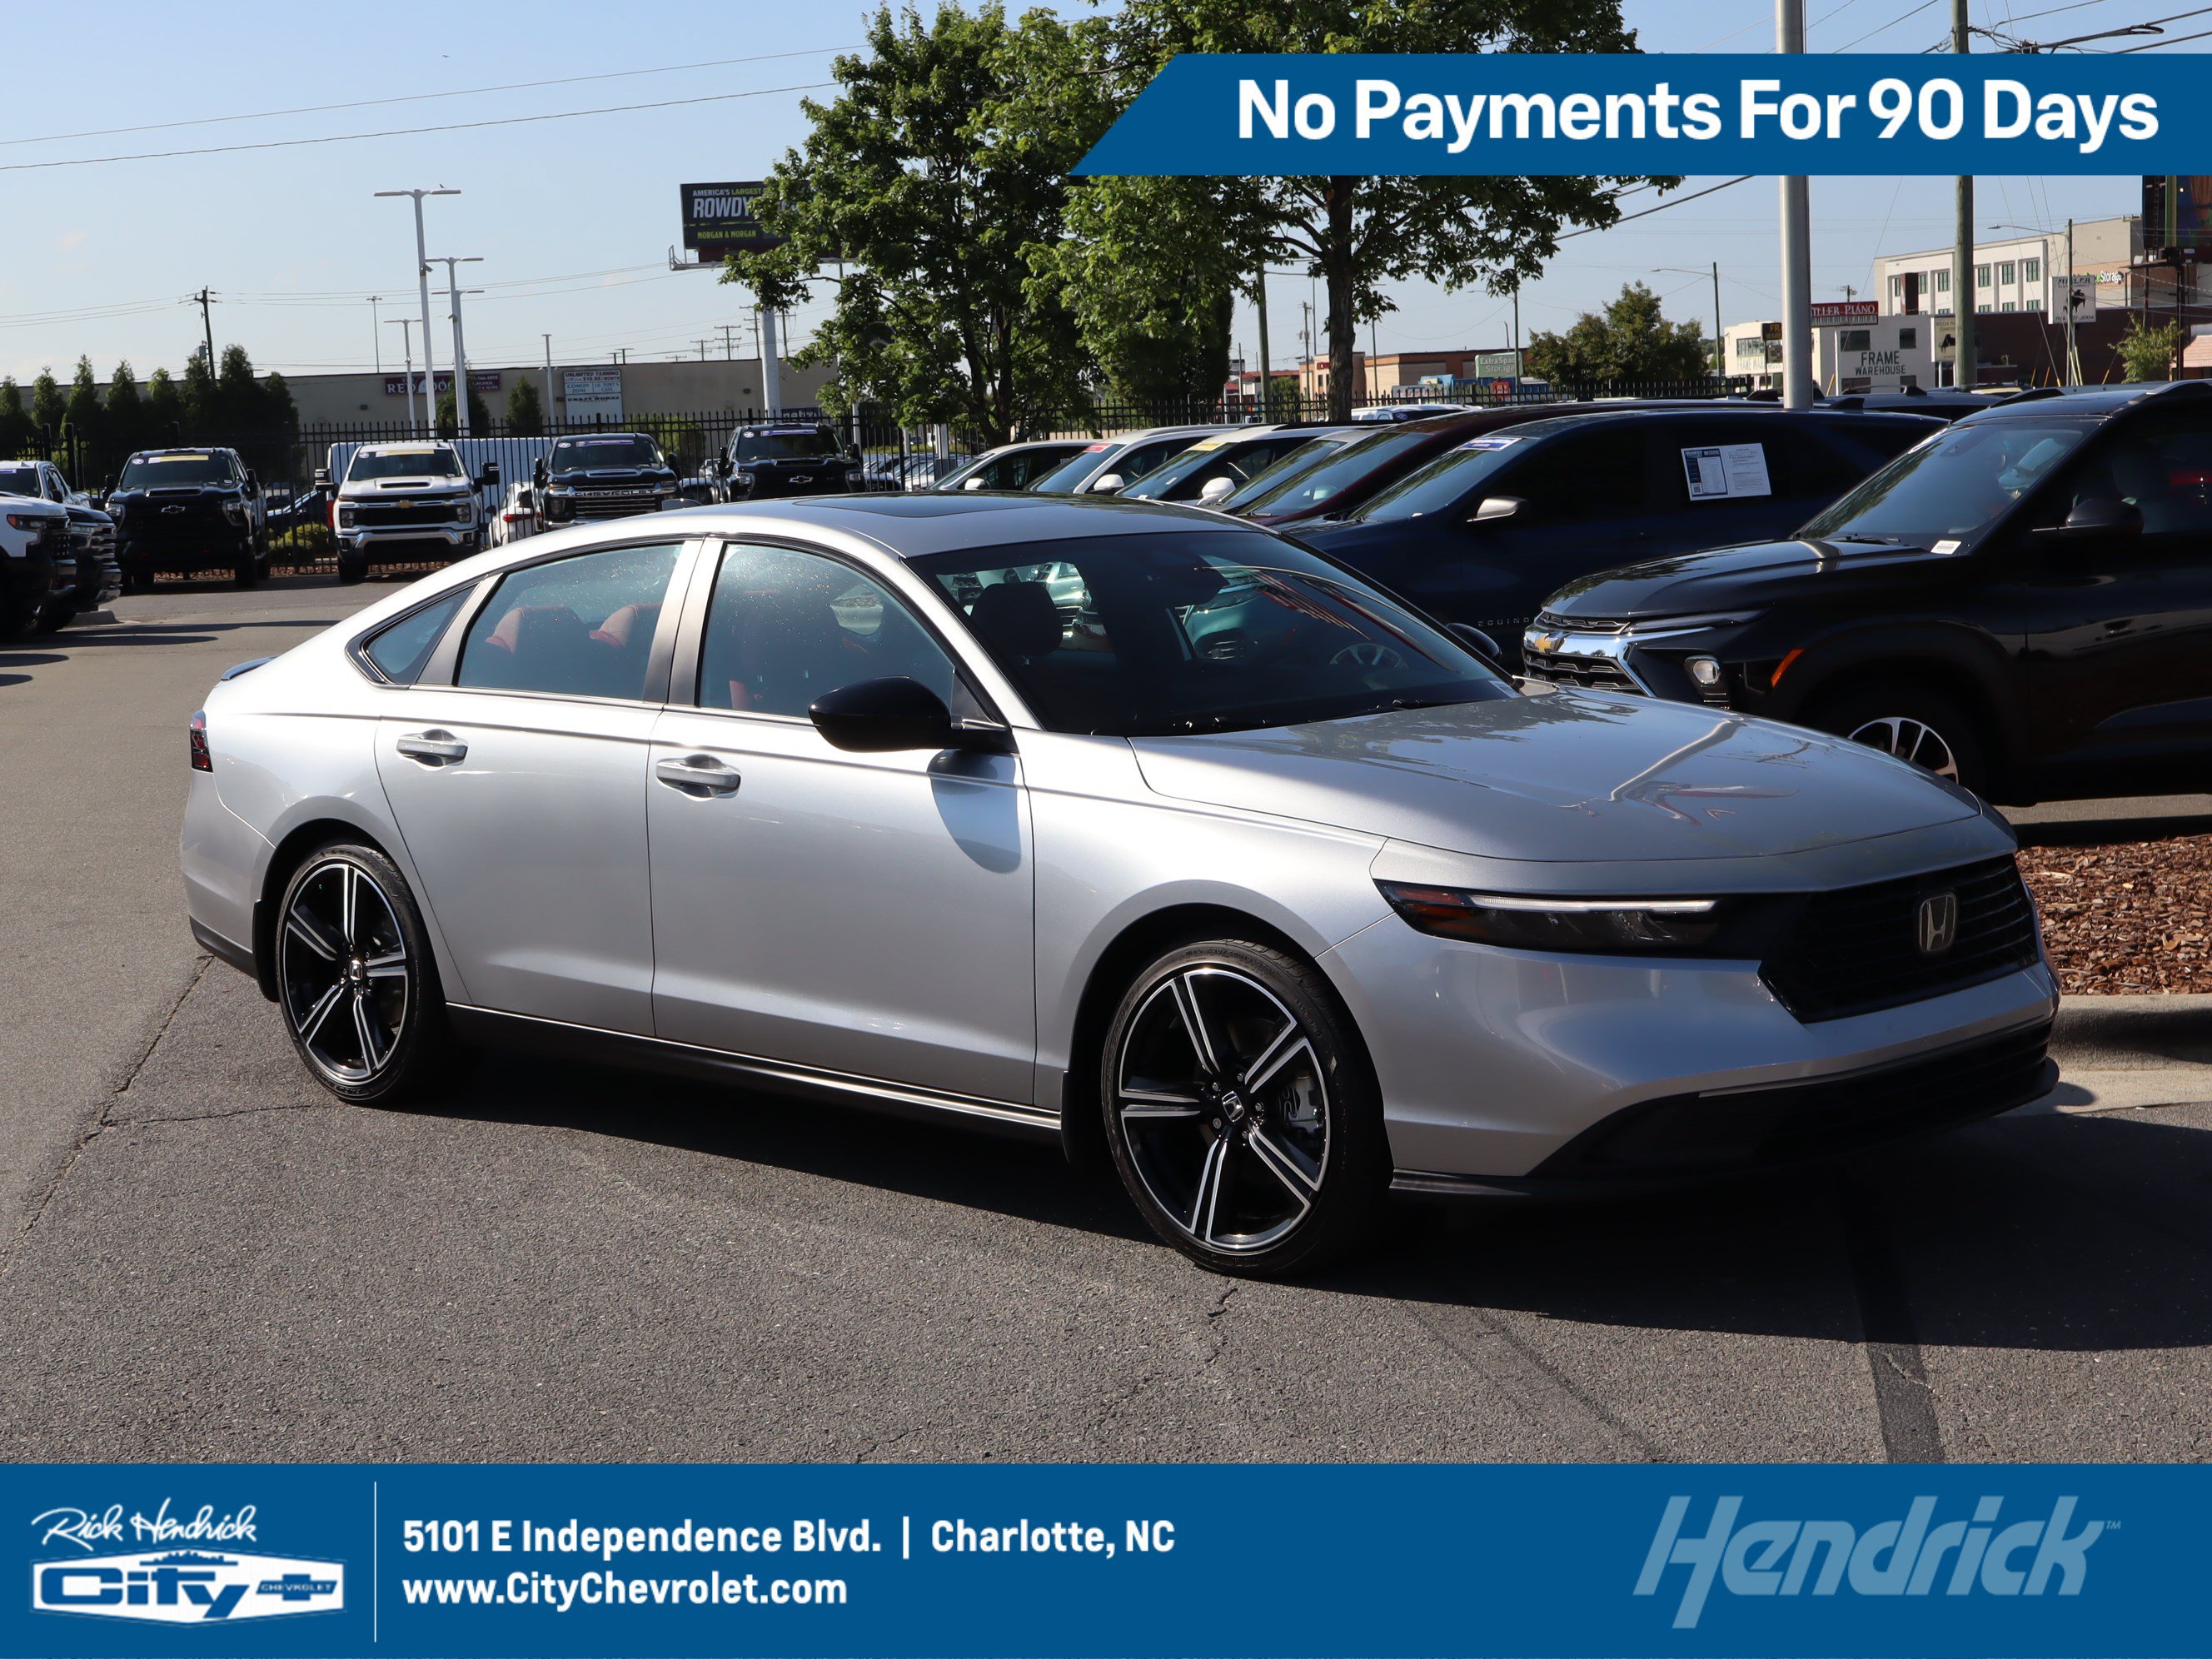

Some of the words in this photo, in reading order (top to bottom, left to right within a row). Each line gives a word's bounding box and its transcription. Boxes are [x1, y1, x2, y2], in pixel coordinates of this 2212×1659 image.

[693, 197, 755, 218] ROWDY
[697, 231, 724, 239] MORGAN
[1811, 306, 1840, 316] ILLER
[1844, 304, 1876, 315] PIANO
[1861, 351, 1900, 366] FRAME
[1855, 365, 1906, 376] WAREHOUSE
[1477, 617, 1530, 627] EQUINO
